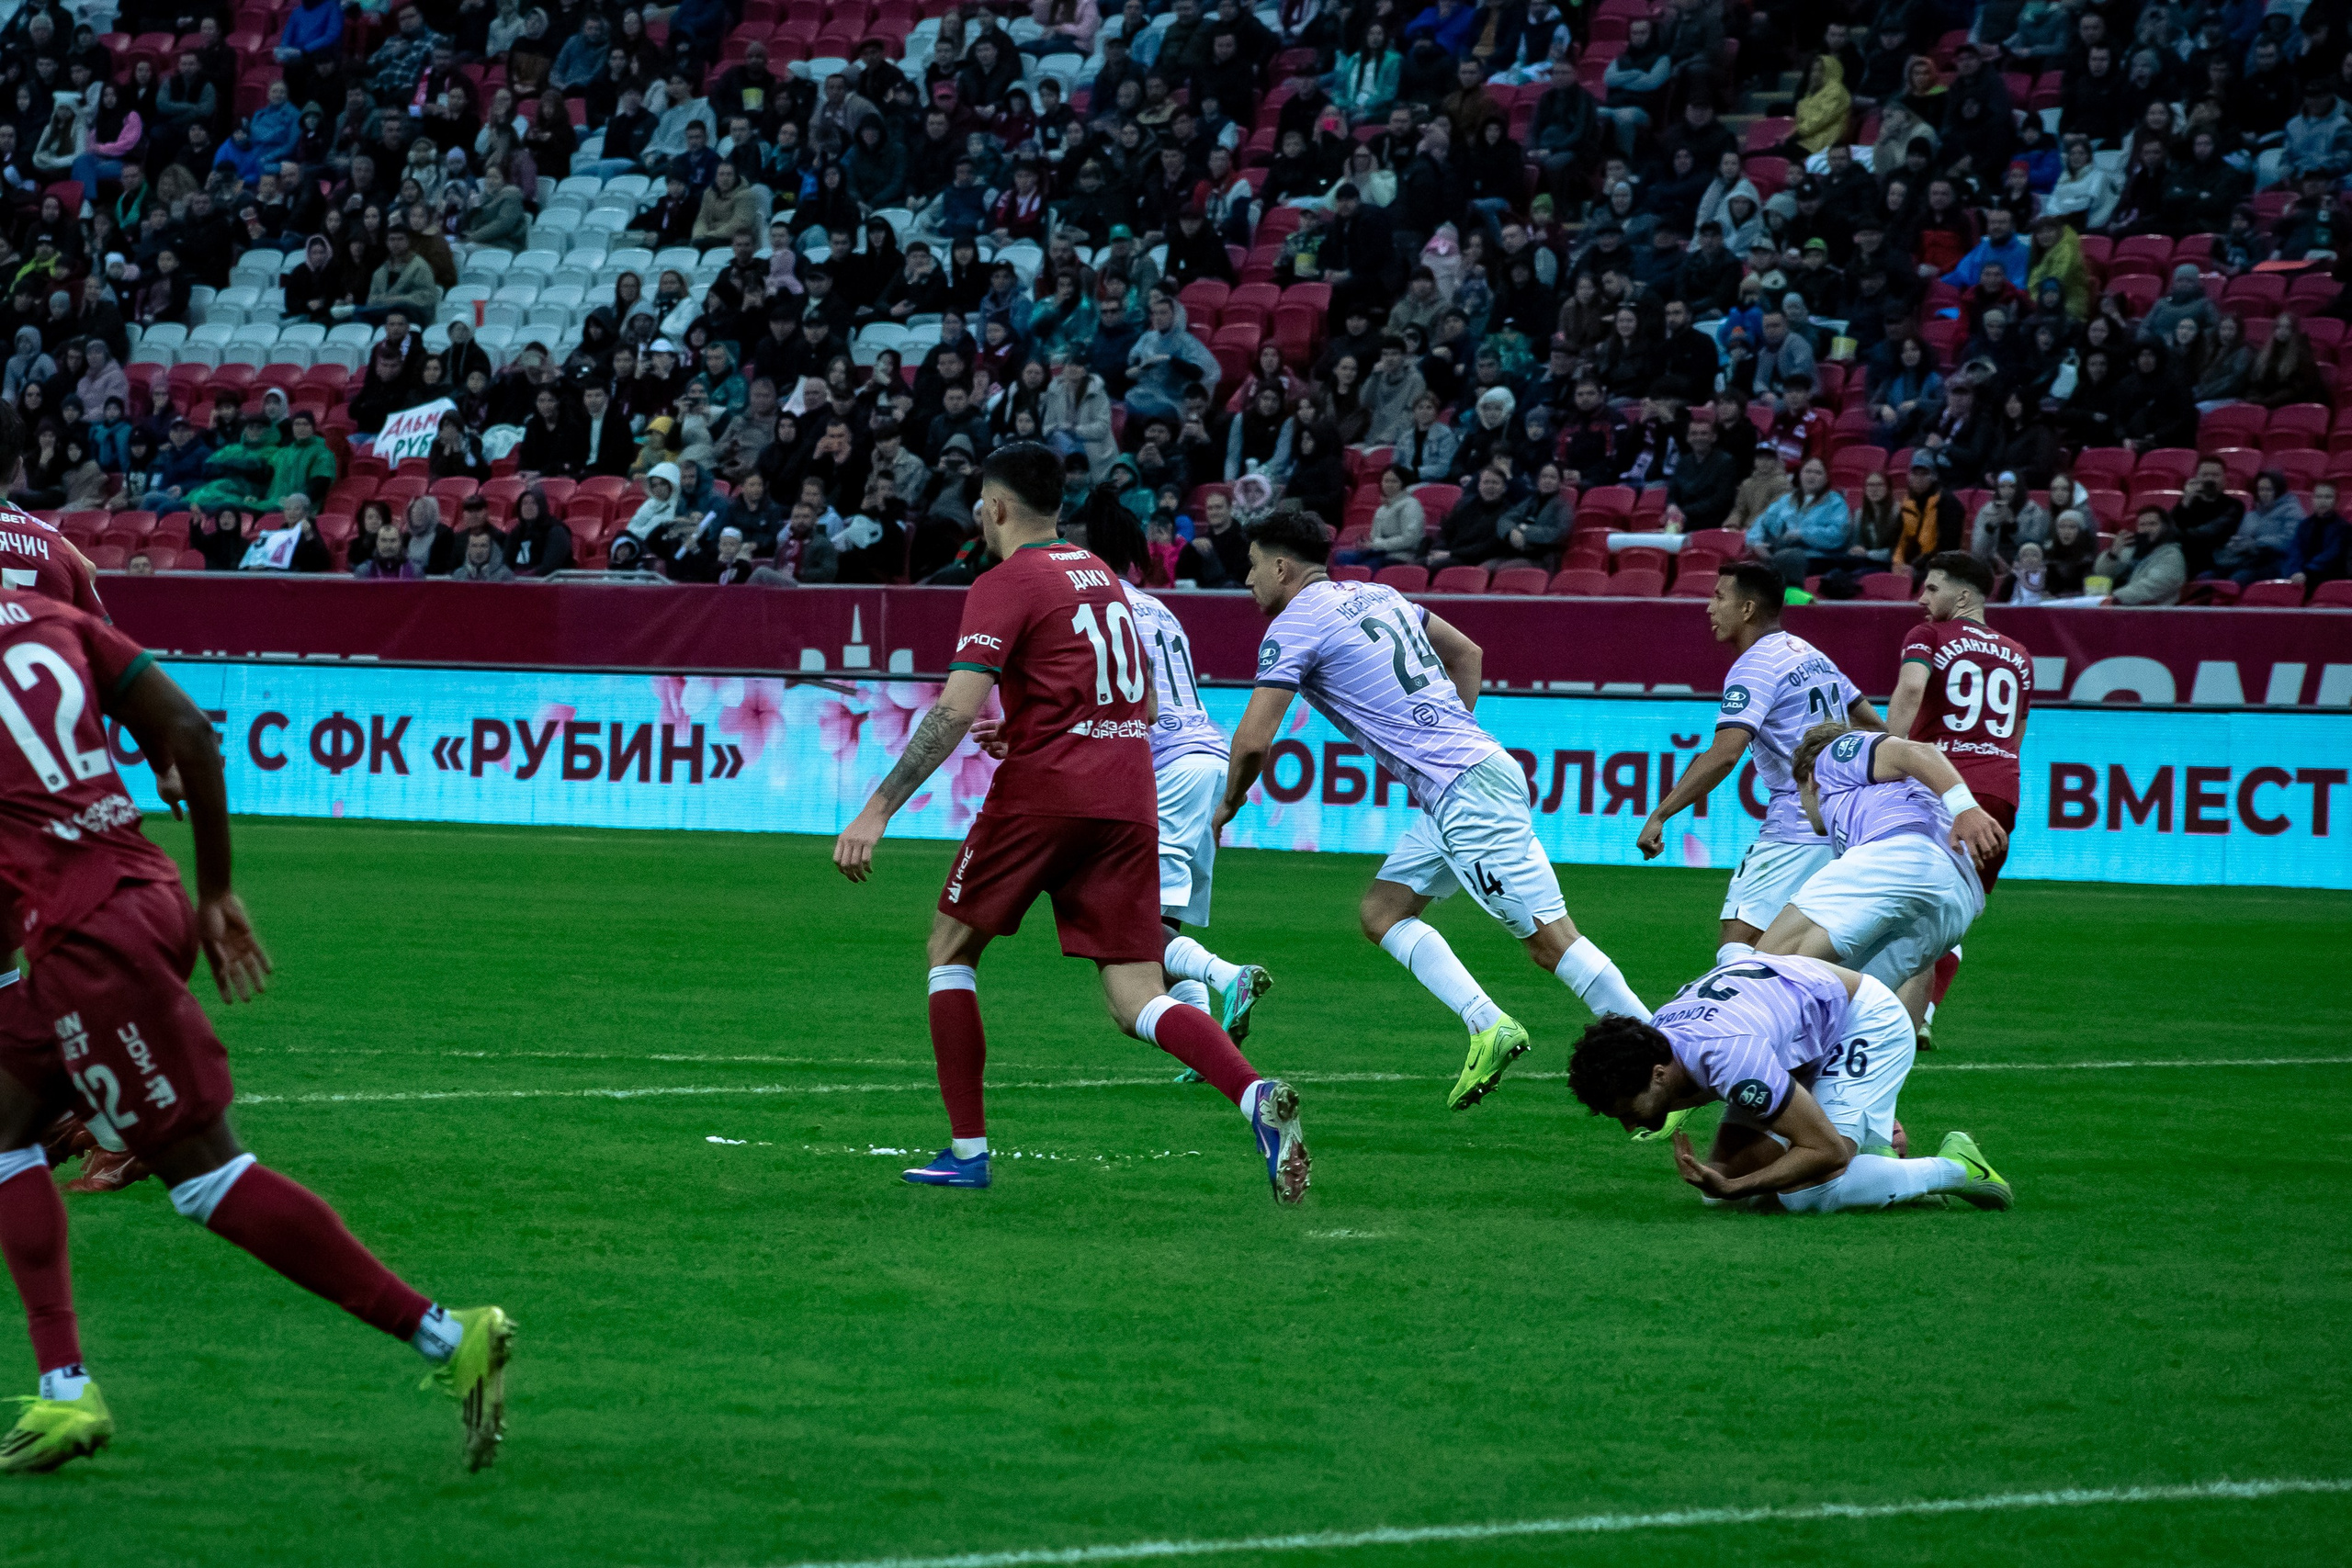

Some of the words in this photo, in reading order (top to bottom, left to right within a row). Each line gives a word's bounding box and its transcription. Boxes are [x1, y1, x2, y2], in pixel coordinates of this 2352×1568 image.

[1048, 549, 1091, 561] FONBET
[1065, 570, 1111, 592] ДАКУ
[1071, 601, 1144, 706] 10
[1155, 628, 1203, 711] 11
[1360, 607, 1449, 695] 24
[1942, 660, 2018, 739] 99
[248, 711, 290, 772] С
[310, 711, 413, 775] ФК
[431, 717, 745, 784] «РУБИН»
[2048, 761, 2348, 838] ВМЕСТ
[1822, 1038, 1868, 1077] 26
